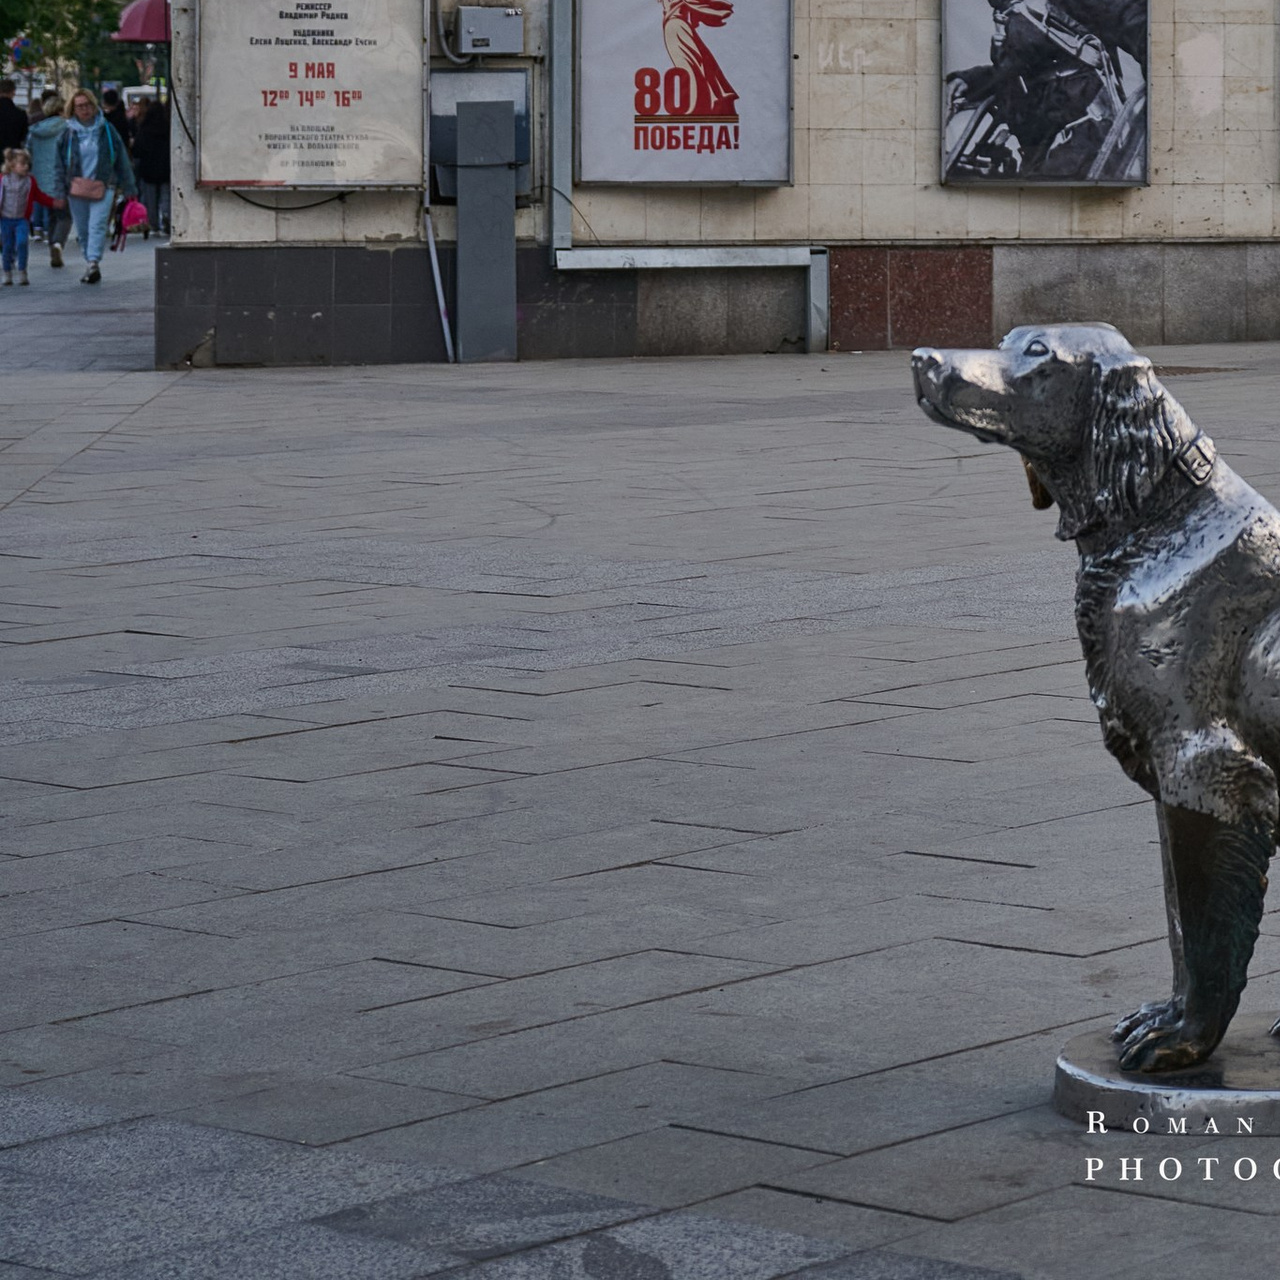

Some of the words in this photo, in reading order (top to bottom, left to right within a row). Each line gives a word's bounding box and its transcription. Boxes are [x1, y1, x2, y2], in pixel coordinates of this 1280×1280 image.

[289, 62, 298, 78] 9
[305, 62, 335, 78] МАЯ
[634, 67, 691, 115] 80
[634, 125, 740, 154] ПОБЕДА!
